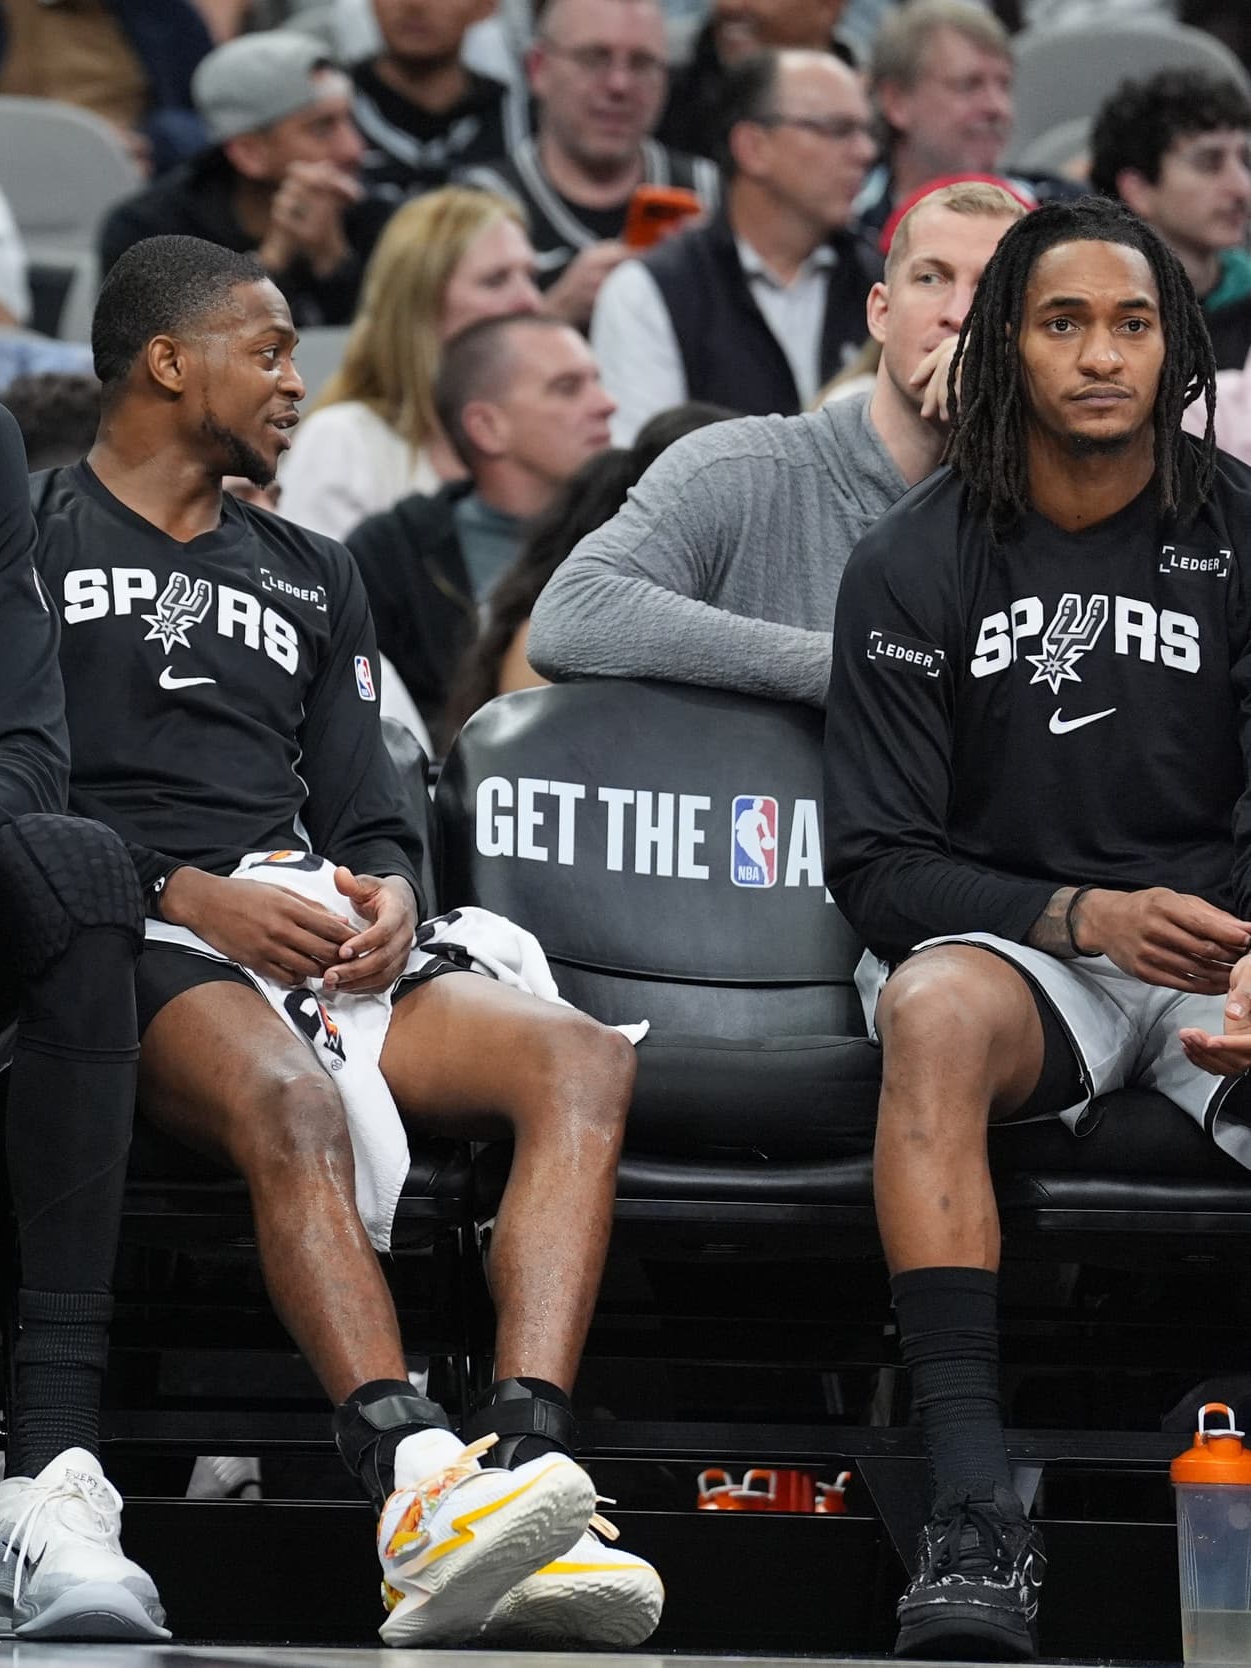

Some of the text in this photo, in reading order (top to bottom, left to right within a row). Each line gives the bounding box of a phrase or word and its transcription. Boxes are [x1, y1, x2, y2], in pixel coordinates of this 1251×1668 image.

[269, 576, 319, 603] LEDGER
[1169, 553, 1221, 572] LEDGER
[63, 567, 299, 676] SPURS
[970, 593, 1201, 679] SPURS
[875, 640, 934, 668] LEDGER
[475, 776, 835, 904] GET THE NBA A
